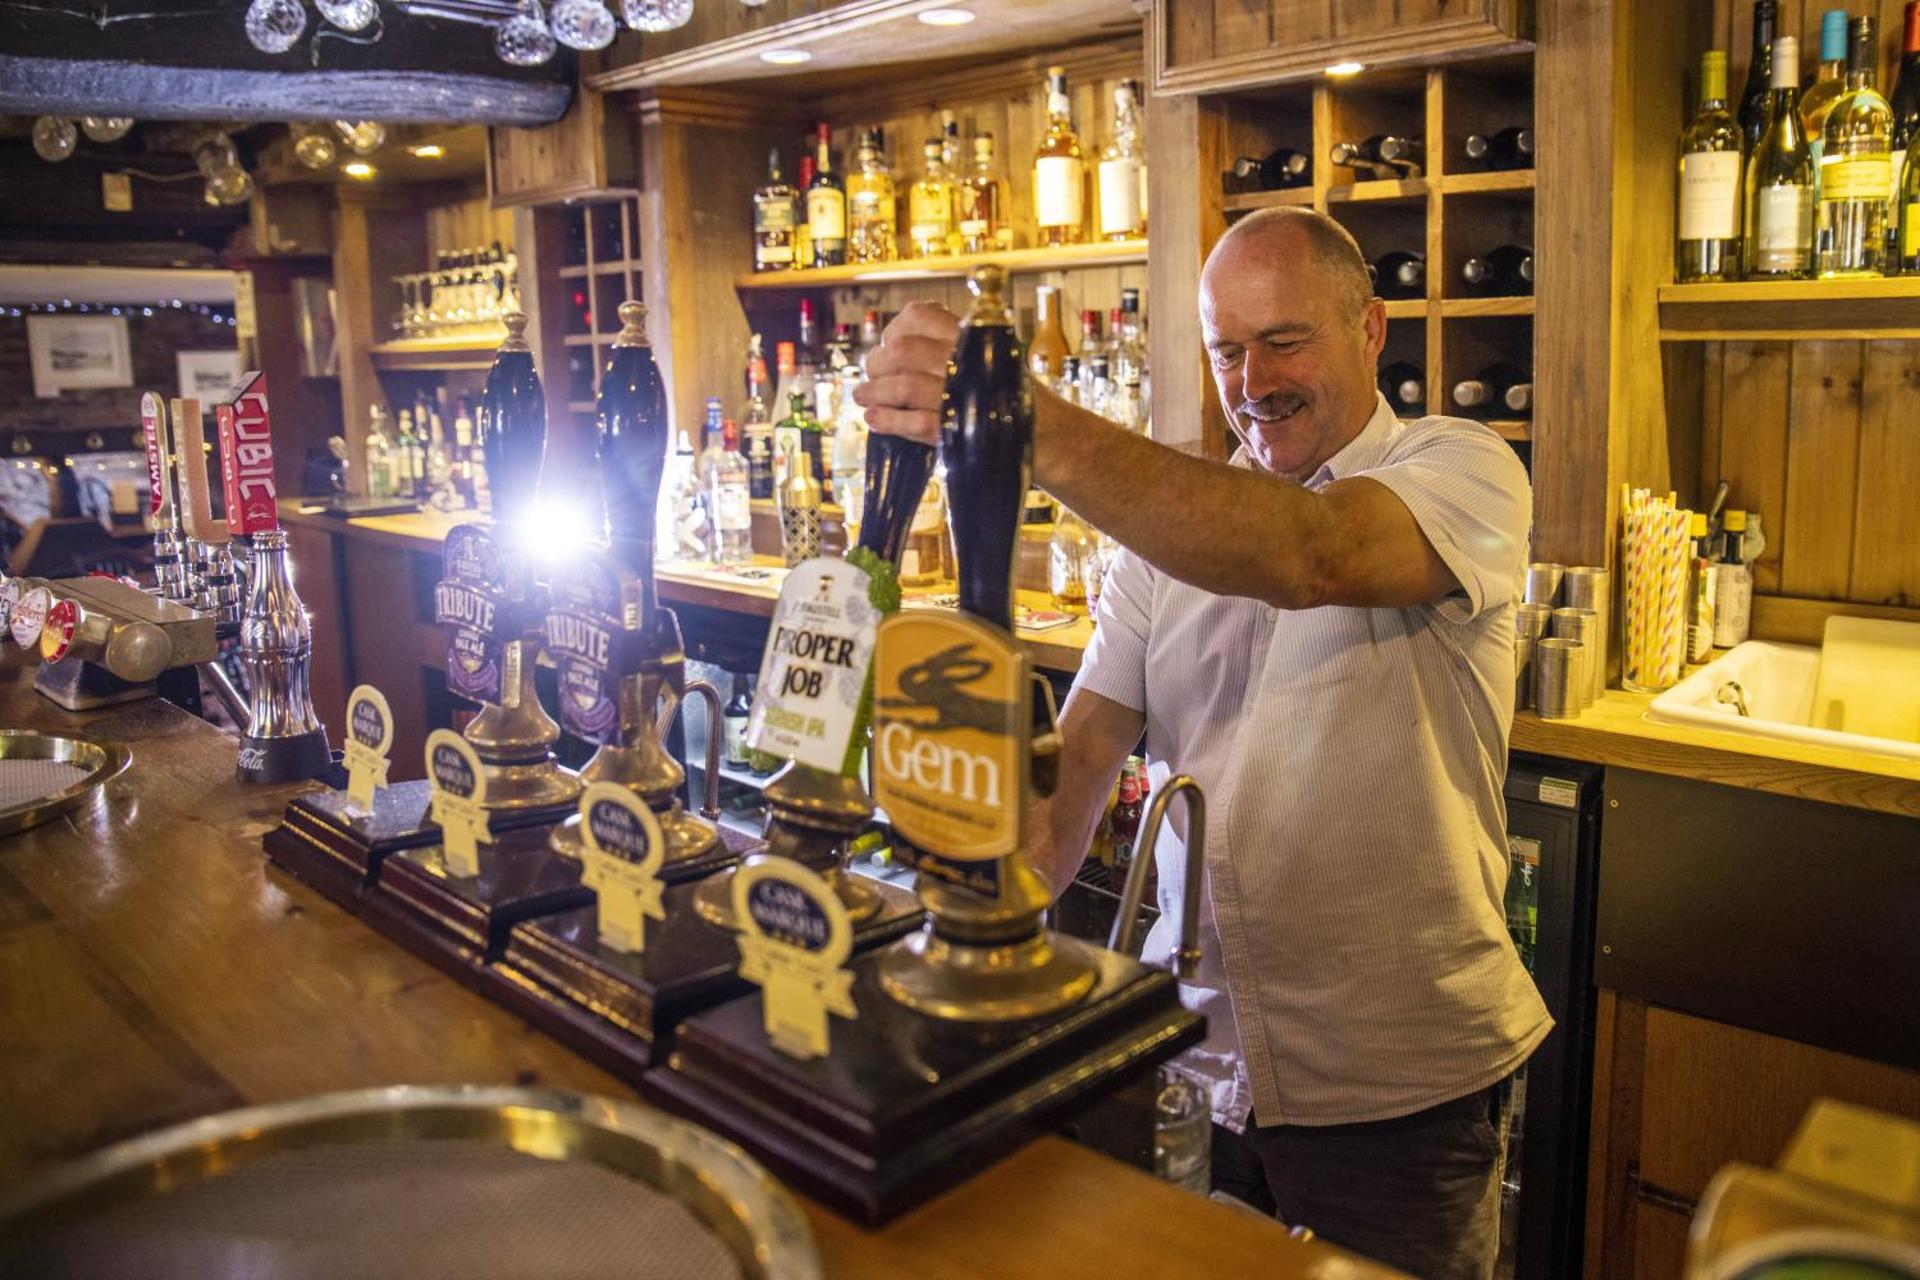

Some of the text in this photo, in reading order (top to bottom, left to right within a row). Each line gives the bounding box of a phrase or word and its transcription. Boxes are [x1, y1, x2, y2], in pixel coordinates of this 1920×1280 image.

[145, 419, 161, 497] AMSTEL
[220, 415, 236, 526] CUBIC
[235, 392, 277, 501] CUBIC
[436, 584, 495, 632] TRIBUTE
[546, 614, 610, 665] TRIBUTE
[773, 626, 855, 669] PROPER
[781, 664, 823, 698] JOB
[882, 722, 1001, 807] Gem
